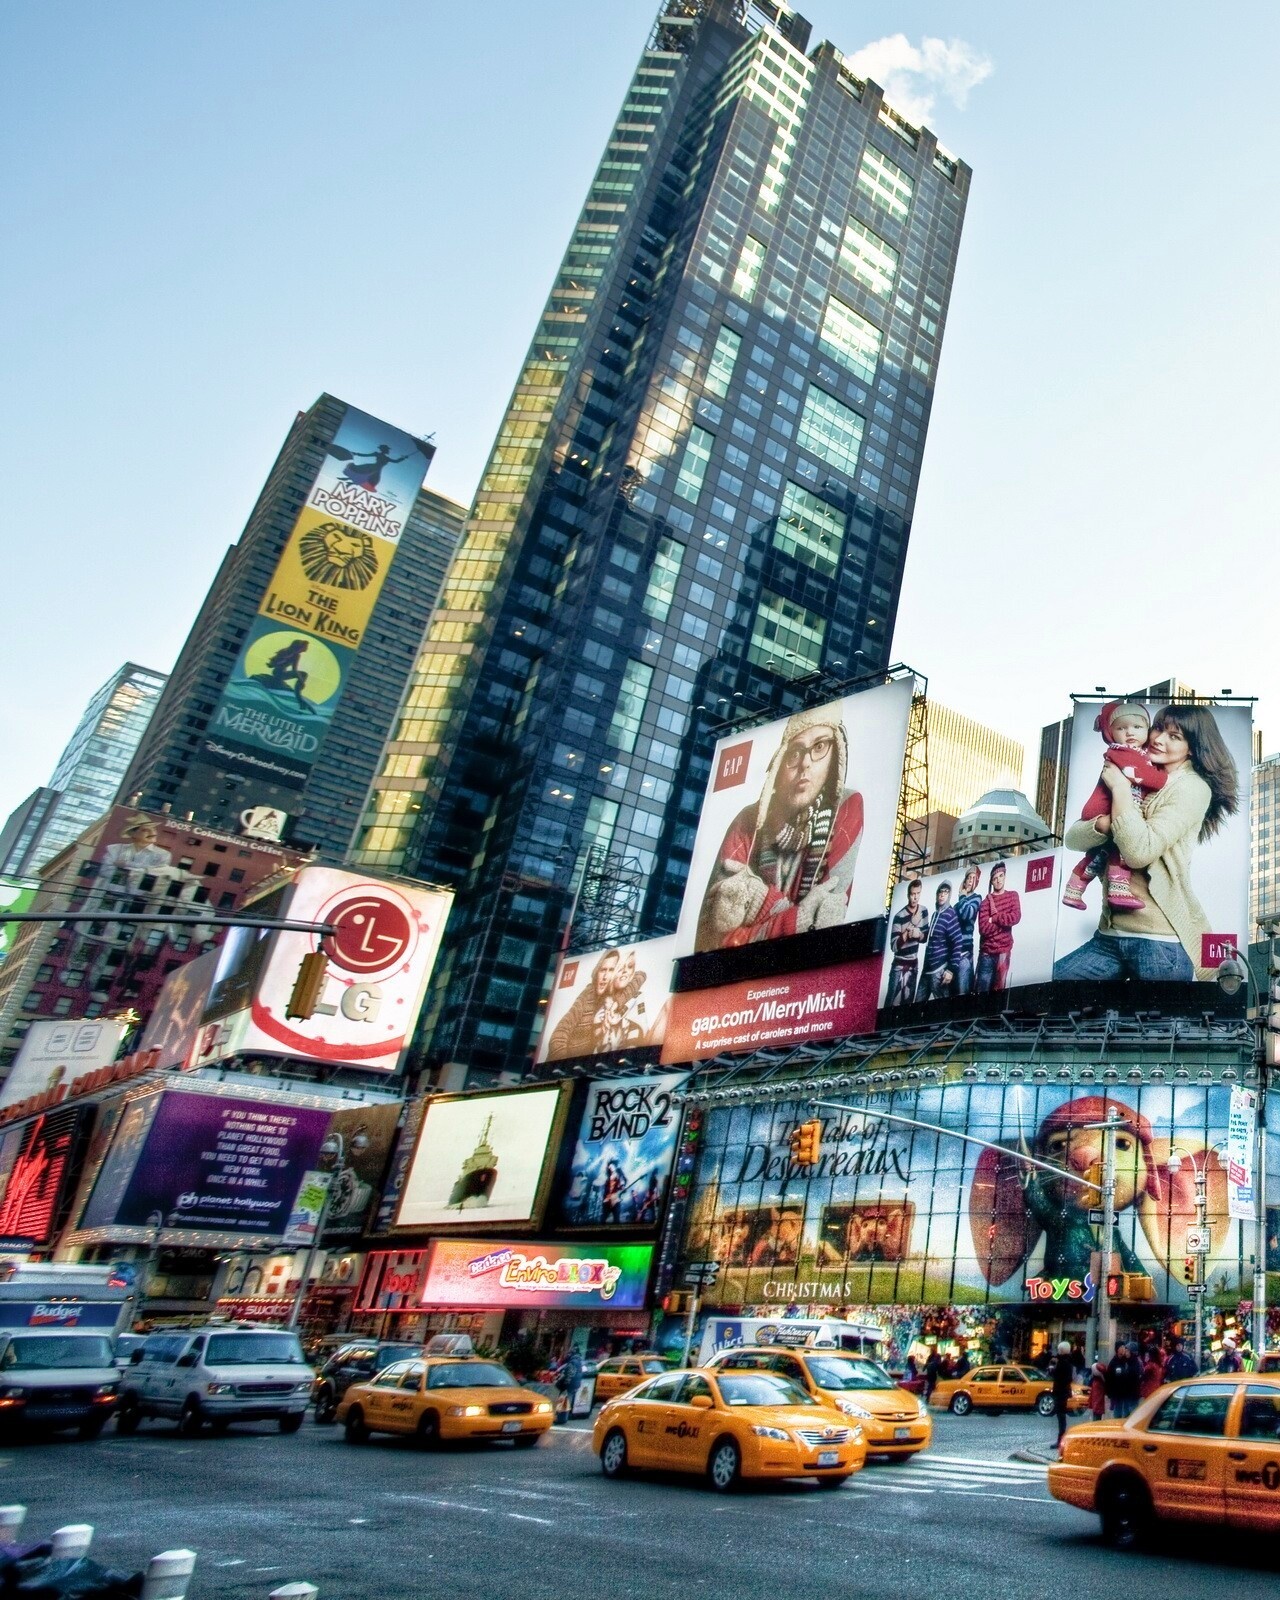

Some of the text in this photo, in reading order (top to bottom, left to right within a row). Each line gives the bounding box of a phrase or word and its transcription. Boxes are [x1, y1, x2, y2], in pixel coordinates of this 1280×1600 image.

[312, 488, 402, 537] POPPINS
[331, 481, 397, 518] MARY
[307, 589, 339, 612] THE
[265, 593, 360, 642] LION KING
[244, 707, 269, 723] THE
[215, 706, 319, 753] MERMAID
[722, 755, 743, 779] GAP
[165, 820, 283, 855] 100% Colombian Coffee
[1031, 867, 1048, 883] GAP
[562, 968, 574, 983] GAP
[746, 985, 790, 1001] Experience
[691, 989, 847, 1037] gap.com/MerryMixIt
[702, 1036, 733, 1049] surprise
[733, 1033, 750, 1045] cast
[750, 1031, 761, 1042] of
[760, 1026, 793, 1040] carolers
[793, 1022, 810, 1034] and
[810, 1020, 834, 1032] more
[595, 1083, 661, 1122] ROCK
[584, 1091, 673, 1144] BAND 2
[198, 1195, 232, 1206] planet
[233, 1196, 282, 1209] hollywood
[763, 1281, 854, 1300] CHRISTMAS
[34, 1304, 83, 1320] Budget
